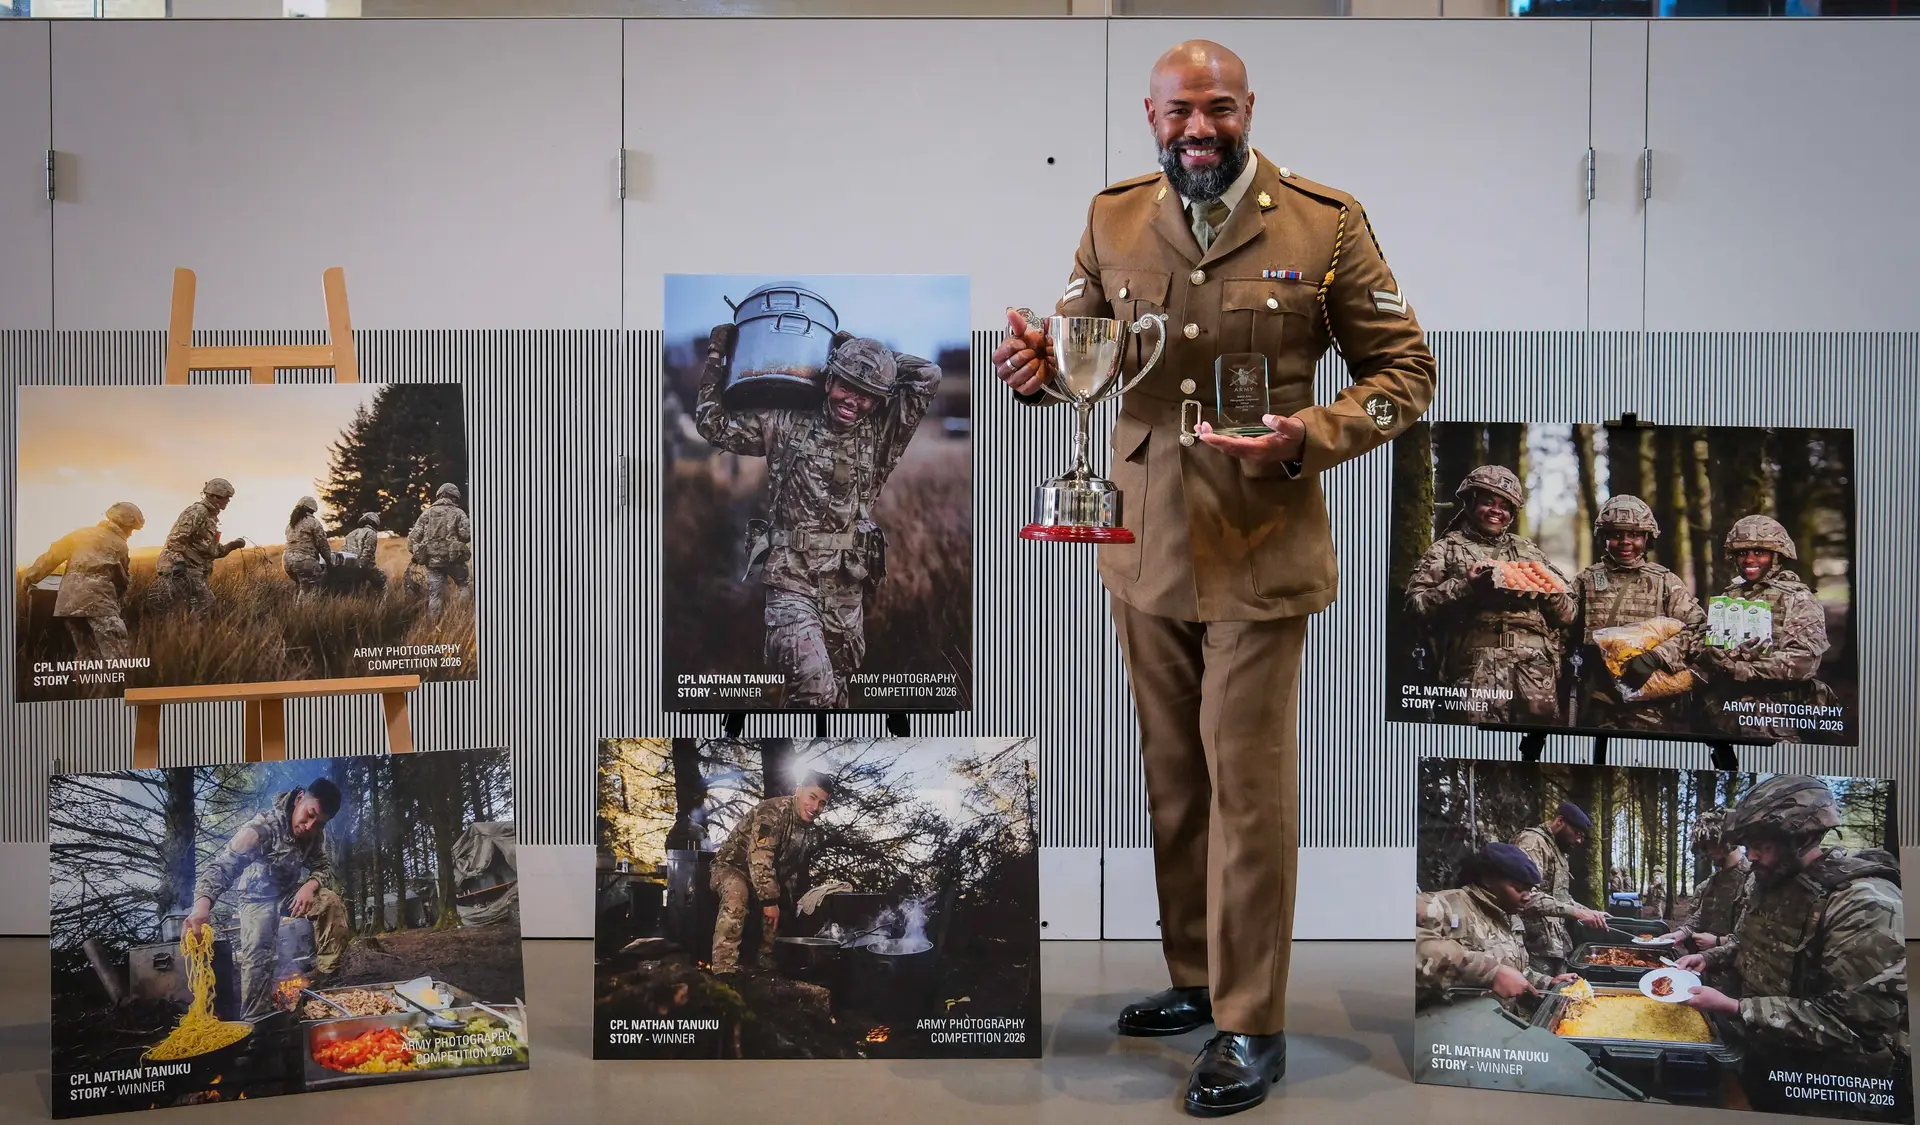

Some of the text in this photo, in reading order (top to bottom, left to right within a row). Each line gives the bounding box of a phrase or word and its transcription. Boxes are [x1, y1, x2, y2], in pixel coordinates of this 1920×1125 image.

[353, 644, 461, 658] ARMY PHOTOGRAPHY
[34, 657, 150, 673] CPL NATHAN TANUKU
[368, 657, 462, 671] COMPETITION 2026
[34, 675, 69, 687] STORY
[79, 672, 125, 684] WINNER
[677, 674, 785, 684] CPL NATHAN TANUKU
[850, 674, 957, 684] ARMY PHOTOGRAPHY
[677, 687, 711, 698] STORY
[719, 687, 762, 698] WINNER
[864, 687, 957, 697] COMPETITION 2026
[1402, 685, 1513, 700] CPL NATHAN TANUKU
[1401, 698, 1435, 709] STORY
[1444, 700, 1488, 712] WINNER
[1723, 701, 1843, 717] ARMY PHOTOGRAPHY
[1738, 715, 1844, 731] COMPETITION 2026
[609, 1019, 719, 1030] CPL NATHAN TANUKU
[916, 1018, 1026, 1029] ARMY PHOTOGRAPHY
[400, 1031, 512, 1052] ARMY PHOTOGRAPHY
[609, 1033, 643, 1044] STORY
[652, 1033, 695, 1044] WINNER
[931, 1032, 1026, 1043] COMPETITION 2026
[416, 1045, 513, 1065] COMPETITION 2026
[1431, 1043, 1549, 1063] CPL NATHAN TANUKU
[1431, 1058, 1467, 1071] STORY
[1476, 1061, 1523, 1075] WINNER
[70, 1063, 191, 1086] CPL NATHAN TANUKU
[1768, 1070, 1894, 1091] ARMY PHOTOGRAPHY
[70, 1086, 108, 1101] STORY
[117, 1080, 165, 1096] WINNER
[1785, 1086, 1895, 1106] COMPETITION 2026
